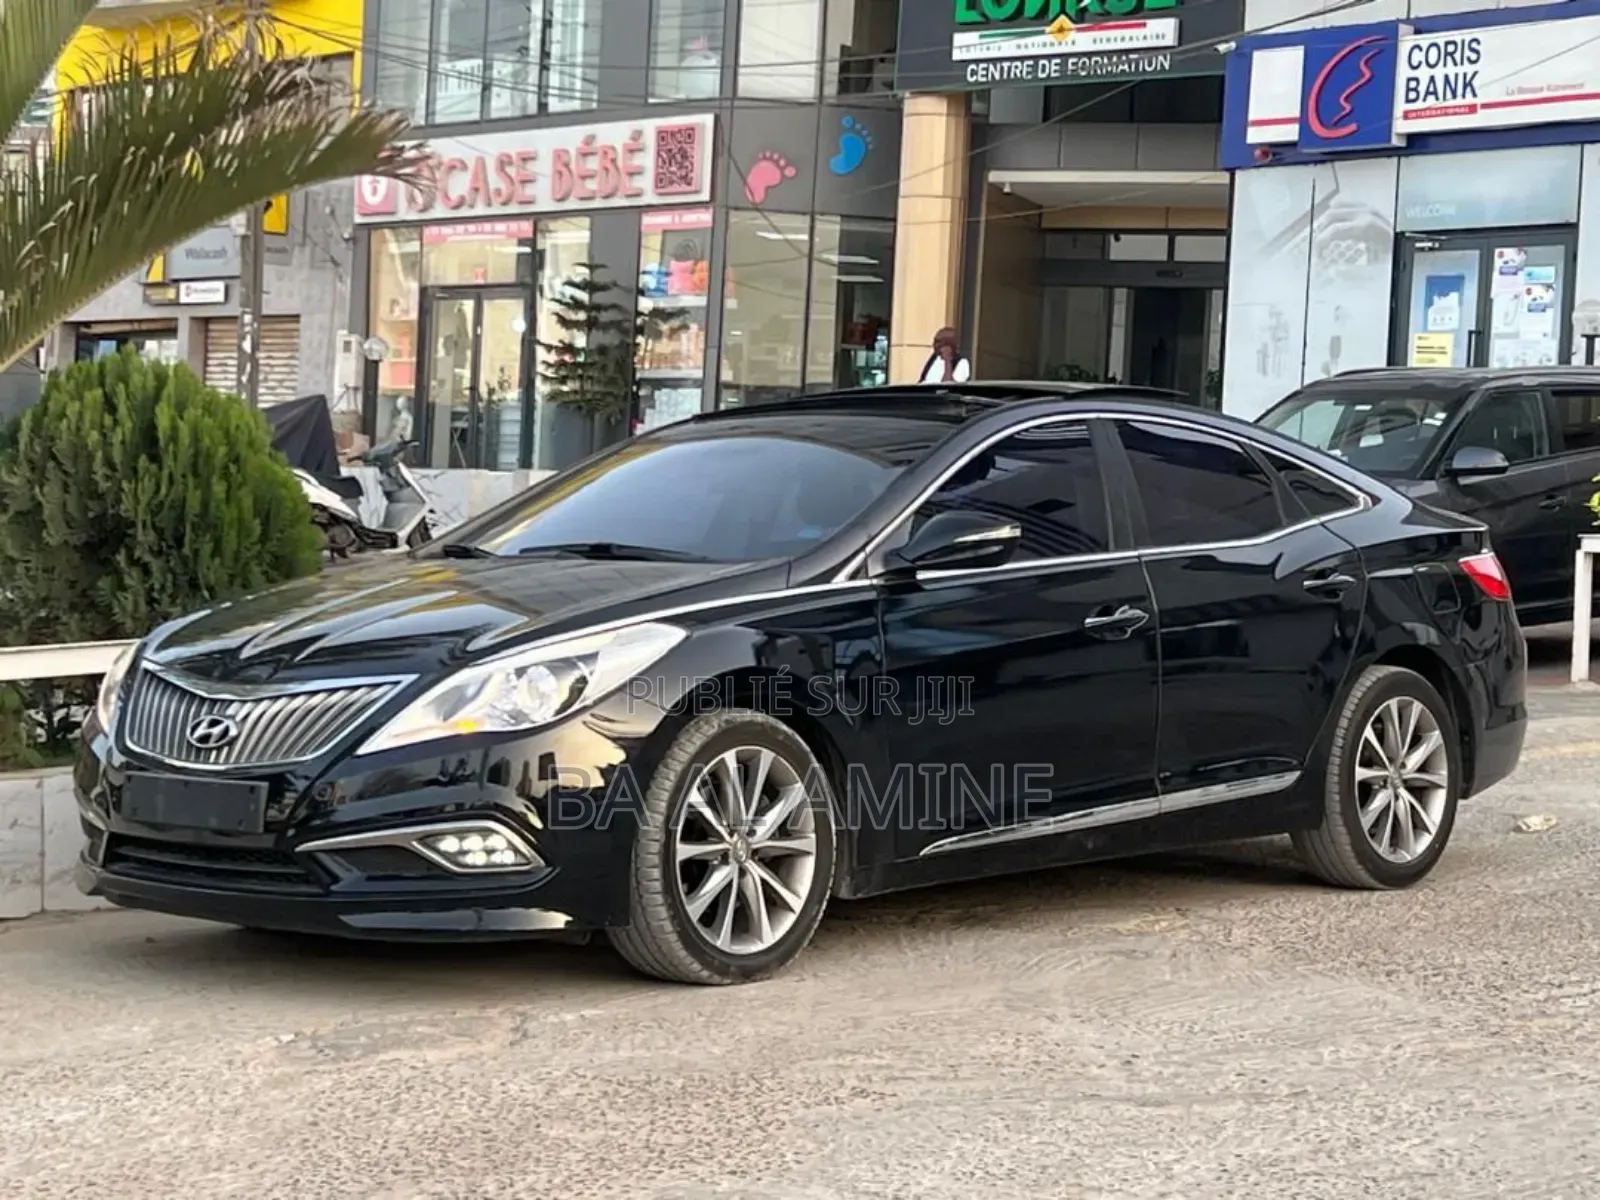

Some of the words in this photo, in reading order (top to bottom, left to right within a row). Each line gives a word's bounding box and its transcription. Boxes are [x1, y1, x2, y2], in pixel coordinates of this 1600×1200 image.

[966, 60, 1034, 82] CENTRE
[1038, 58, 1061, 78] DE
[1067, 53, 1171, 76] FORMATION
[1407, 38, 1481, 70] CORIS
[1405, 71, 1479, 104] BANK
[551, 130, 646, 202] BÉBÉ
